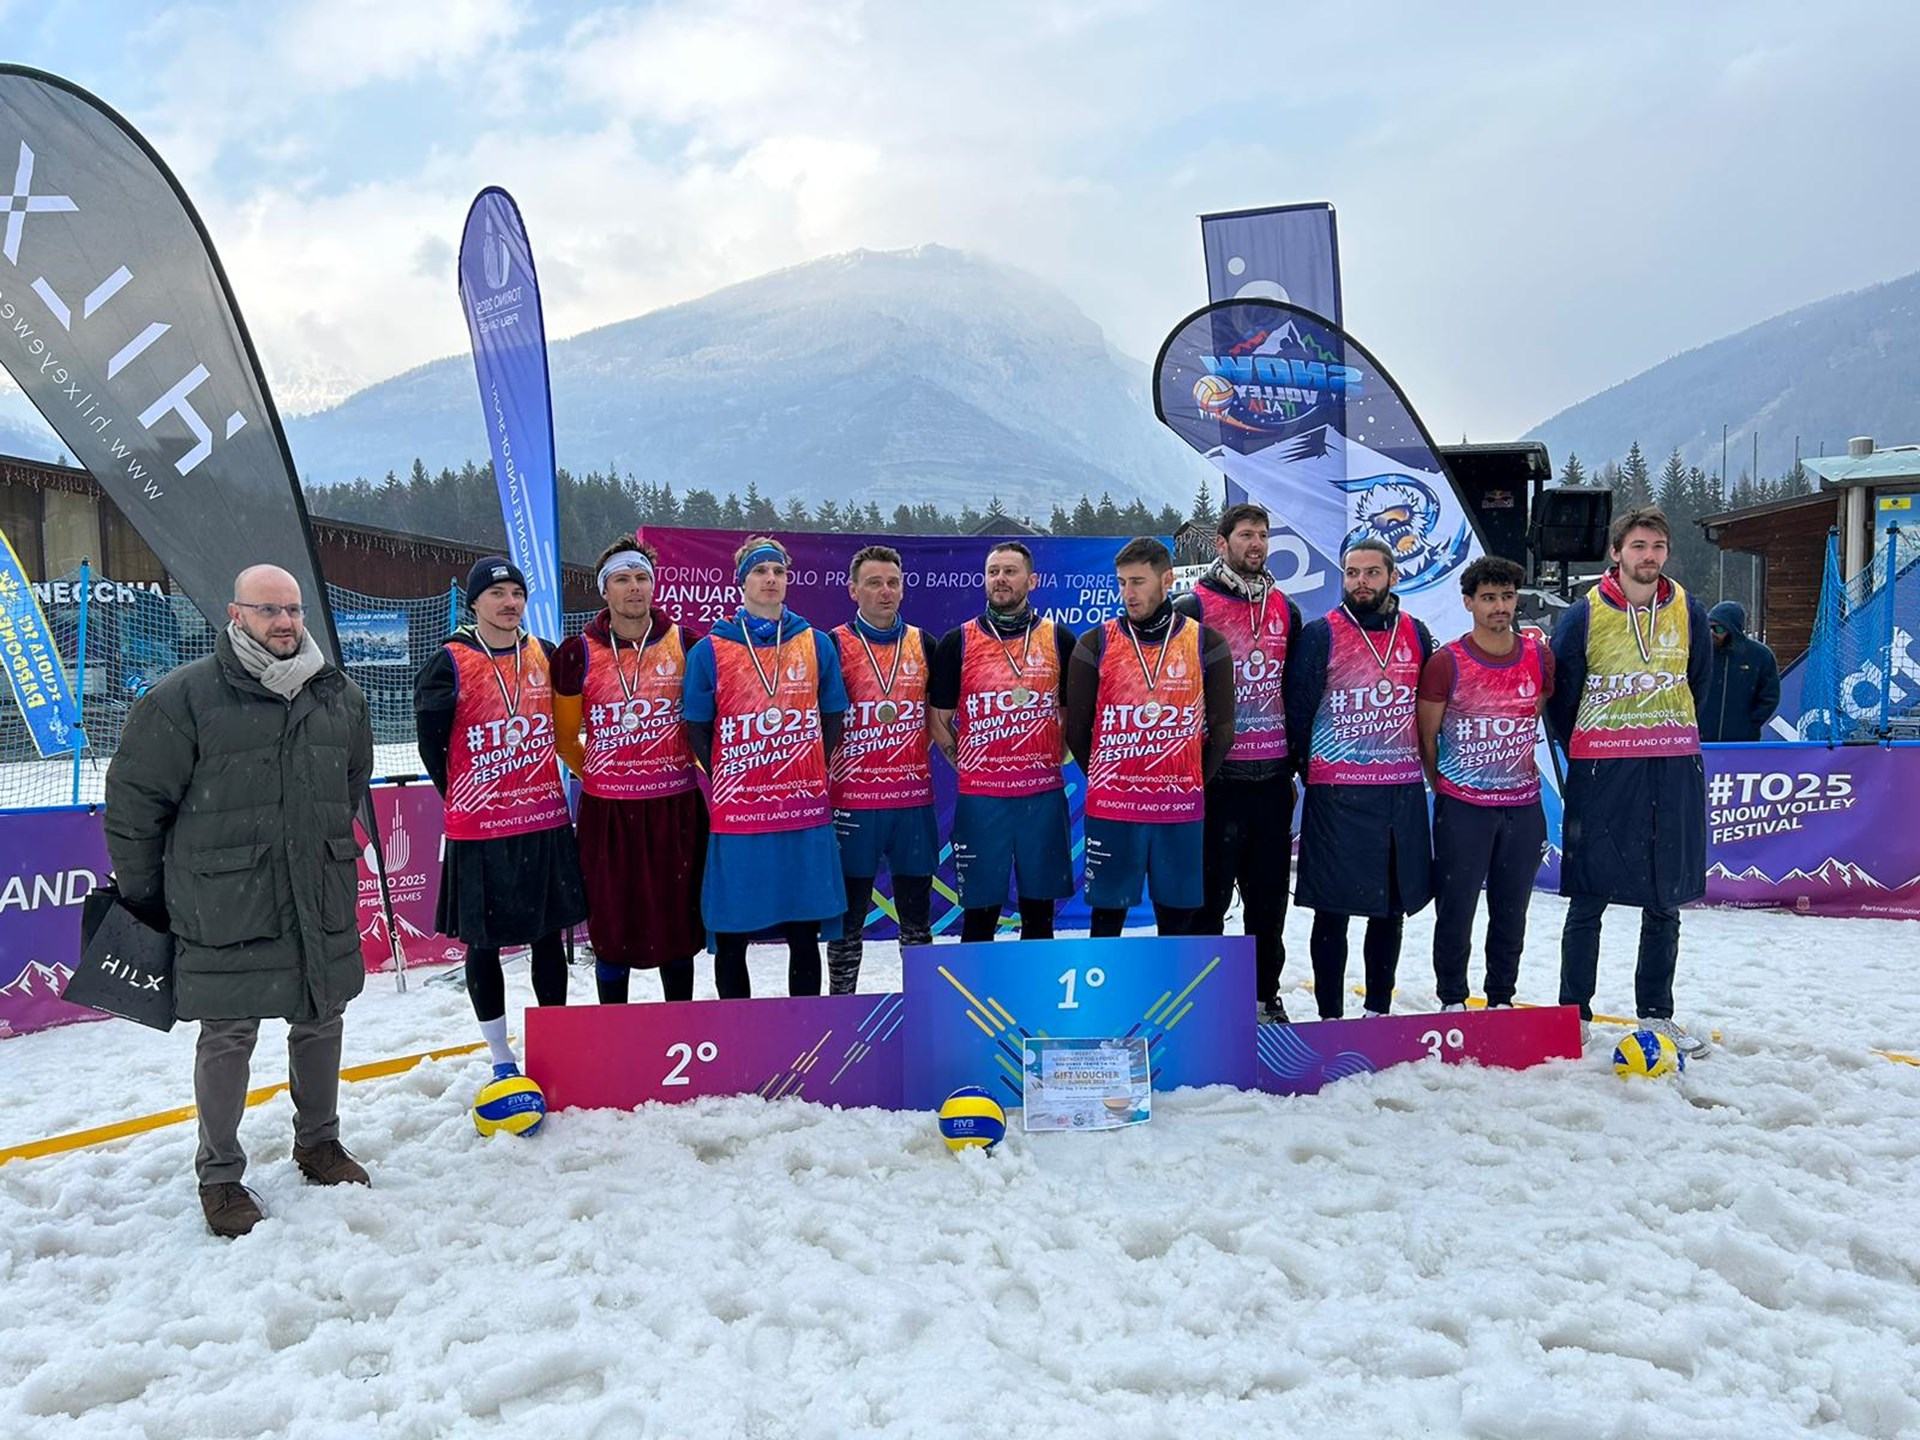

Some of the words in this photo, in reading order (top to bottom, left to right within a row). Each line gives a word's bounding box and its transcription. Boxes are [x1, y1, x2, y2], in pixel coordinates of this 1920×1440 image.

[656, 566, 723, 583] TORINO
[926, 572, 1058, 589] BARDOHIA
[1064, 574, 1115, 589] TORRE
[655, 585, 745, 603] JANUARY
[1079, 588, 1124, 606] PIEM
[720, 708, 818, 745] #TO25
[968, 712, 1006, 733] SNOW
[1102, 704, 1195, 731] #TO25
[1333, 710, 1380, 727] SNOW
[843, 724, 883, 745] SNOW
[970, 723, 1029, 748] FESTIVAL
[1099, 730, 1142, 748] SNOW
[1145, 727, 1196, 741] VOLLEY
[1334, 718, 1402, 741] FESTIVAL
[594, 729, 660, 752] FESTIVAL
[721, 736, 766, 761] SNOW
[771, 729, 821, 748] VOLLEY
[843, 735, 904, 759] FESTIVAL
[1458, 738, 1503, 755] SNOW
[1589, 739, 1630, 748] PIEMONTE
[1632, 738, 1657, 747] LAND
[1660, 737, 1672, 745] OF
[471, 745, 516, 770] SNOW
[1099, 742, 1164, 763] FESTIVAL
[1459, 747, 1521, 769] FESTIVAL
[471, 751, 542, 786] FESTIVAL
[722, 749, 790, 779] FESTIVAL
[597, 783, 634, 793] PIEMONTE
[635, 781, 658, 791] LAND
[658, 780, 668, 789] OF
[970, 779, 1006, 788] PIEMONTE
[1006, 778, 1027, 788] LAND
[1027, 778, 1038, 787] OF
[1038, 775, 1056, 785] SPORT
[1335, 772, 1377, 781] PIEMONTE
[1378, 772, 1399, 781] LAND
[843, 791, 879, 801] PIEMONTE
[881, 791, 900, 800] LAND
[901, 790, 911, 798] OF
[911, 788, 929, 798] SPORT
[1708, 772, 1853, 807] #TO25
[725, 812, 766, 822] PIEMONTE
[767, 809, 789, 820] LAND
[790, 809, 801, 819] OF
[803, 806, 825, 817] SPORT
[1096, 801, 1136, 811] PIEMONTE
[1137, 802, 1160, 811] LAND
[1160, 803, 1171, 812] OF
[1172, 802, 1196, 811] SPORT
[1710, 804, 1771, 826] SNOW
[1776, 797, 1856, 816] VOLLEY
[479, 816, 523, 830] PIEMONTE
[525, 813, 546, 824] LAND
[546, 809, 556, 819] OF
[1712, 817, 1803, 844] FESTIVAL
[357, 876, 396, 892] ORIO
[400, 874, 426, 887] 2025
[390, 891, 422, 904] GAMES
[1861, 904, 1888, 912] Partner
[101, 954, 164, 991] HILX
[1058, 967, 1105, 1009] 1°
[1421, 1028, 1464, 1062] 3°
[662, 1042, 718, 1086] 2°
[1054, 1071, 1073, 1079] GIFT
[1075, 1071, 1119, 1079] VOUCHER
[953, 1119, 975, 1128] FIVB
